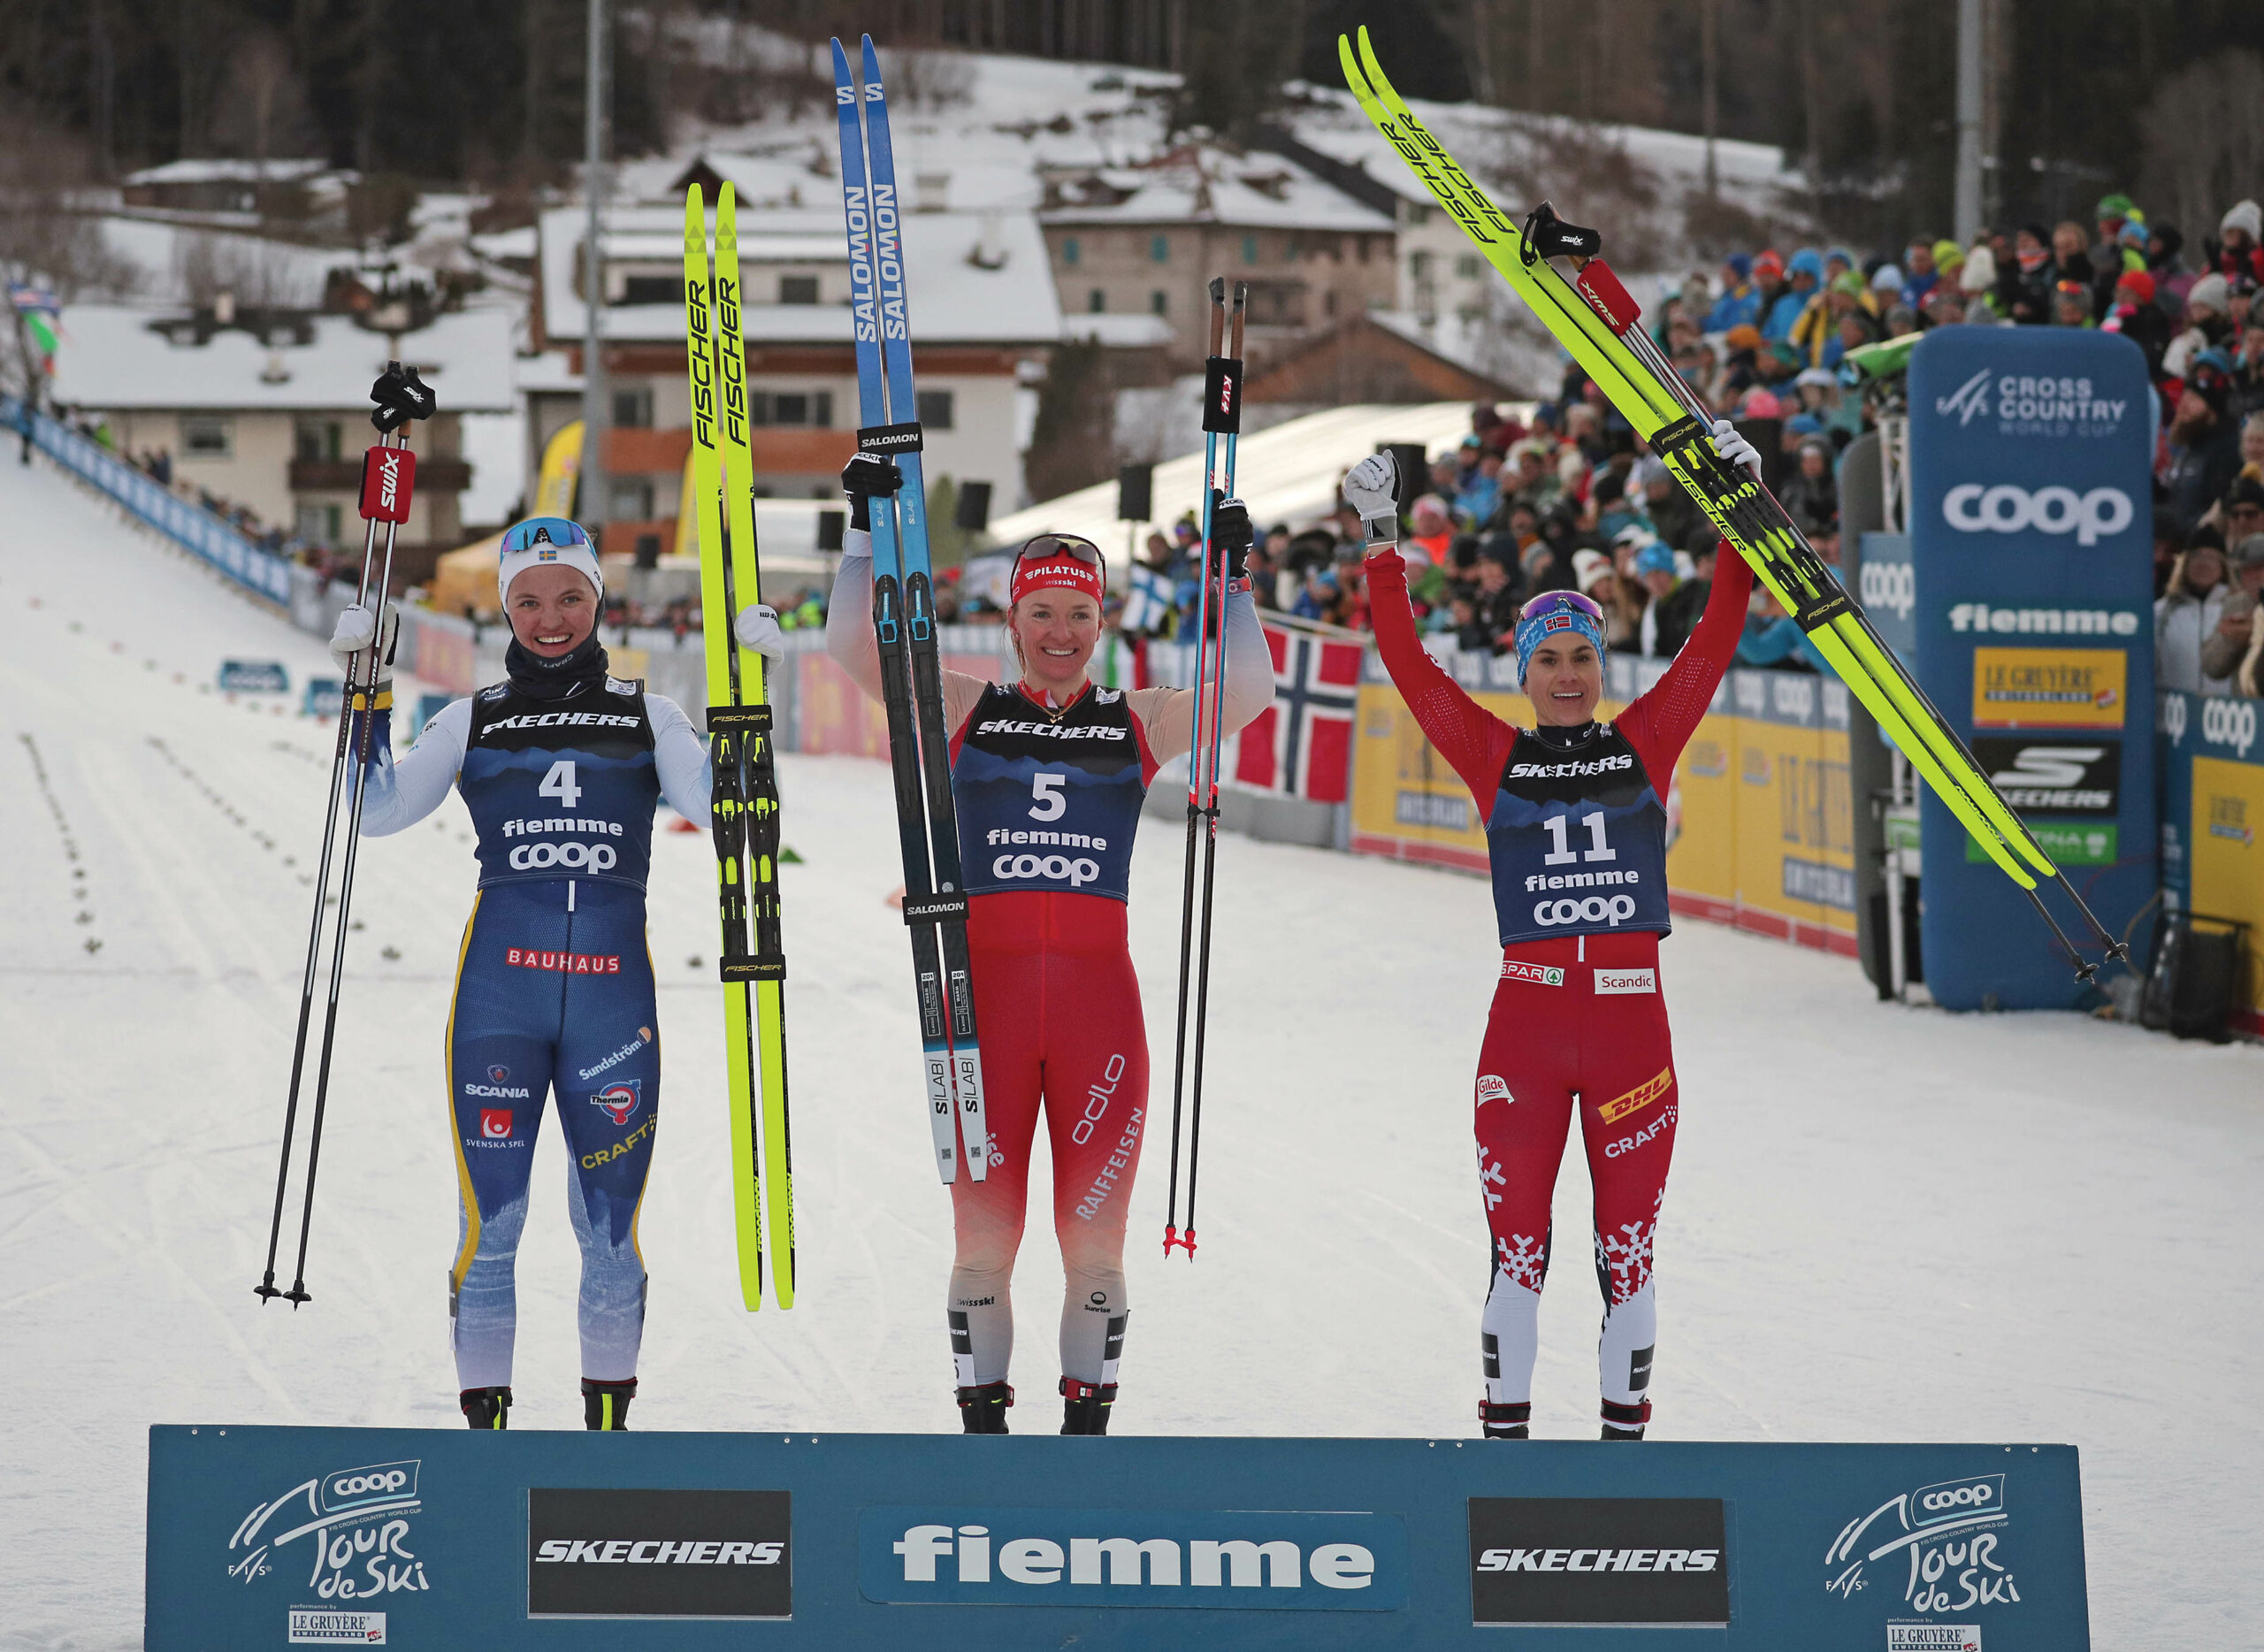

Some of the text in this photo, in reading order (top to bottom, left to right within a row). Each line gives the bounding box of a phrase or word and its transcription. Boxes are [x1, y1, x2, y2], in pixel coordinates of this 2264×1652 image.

[1381, 122, 1498, 244] FISCHER
[1398, 112, 1516, 234] FISCHER
[845, 187, 877, 342] SALOMON
[874, 184, 906, 340] SALOMON
[689, 279, 715, 449] FISCHER
[719, 277, 746, 447] FISCHER
[1999, 376, 2092, 399] CROSS
[1999, 400, 2127, 421] COUNTRY
[861, 433, 919, 447] SALOMON
[1662, 420, 1700, 446] FISCHER
[1671, 466, 1748, 552] FISCHER
[1942, 484, 2134, 547] coop
[1034, 566, 1089, 578] PILATUS
[1860, 562, 1916, 620] coop
[1808, 596, 1845, 621] FISCHER
[1948, 604, 2139, 635] fiemme
[1986, 667, 2006, 687] LE
[480, 712, 640, 739] SKECHERS
[711, 713, 769, 723] FISCHER
[976, 720, 1128, 740] SKECHERS
[2202, 698, 2256, 758] coop
[1509, 754, 1633, 778] SKECHERS
[539, 761, 582, 807] 4
[1028, 773, 1067, 822] 5
[502, 818, 623, 837] fiemme
[987, 829, 1107, 851] fiemme
[1543, 811, 1617, 866] 11
[509, 842, 617, 875] coop
[992, 854, 1100, 887] coop
[1525, 870, 1639, 892] fiemme
[906, 902, 965, 915] SALOMON
[1534, 894, 1636, 926] coop
[509, 950, 620, 972] BAUHAUS
[724, 963, 783, 973] FISCHER
[1501, 964, 1543, 980] SPAR
[1602, 975, 1652, 988] Scandic
[579, 1040, 642, 1081] Sundström
[465, 1083, 530, 1098] SCANIA
[1479, 1079, 1504, 1094] Gilde
[1612, 1076, 1668, 1117] DHL
[591, 1096, 629, 1105] Thermia
[466, 1138, 525, 1149] SVENSKA SPEL
[581, 1123, 647, 1170] CRAFT
[1604, 1113, 1669, 1159] CRAFT
[1075, 1107, 1143, 1220] RAIFFEISEN
[1084, 1304, 1112, 1313] Sunrise
[334, 1470, 407, 1493] coop
[1923, 1484, 1992, 1510] coop
[535, 1541, 784, 1564] SKECHERS
[892, 1524, 1375, 1589] fiemme
[1477, 1549, 1720, 1572] SKECHERS
[294, 1612, 366, 1630] LE GRUYÈRE
[1892, 1626, 1962, 1643] LE GRUYÈRE
